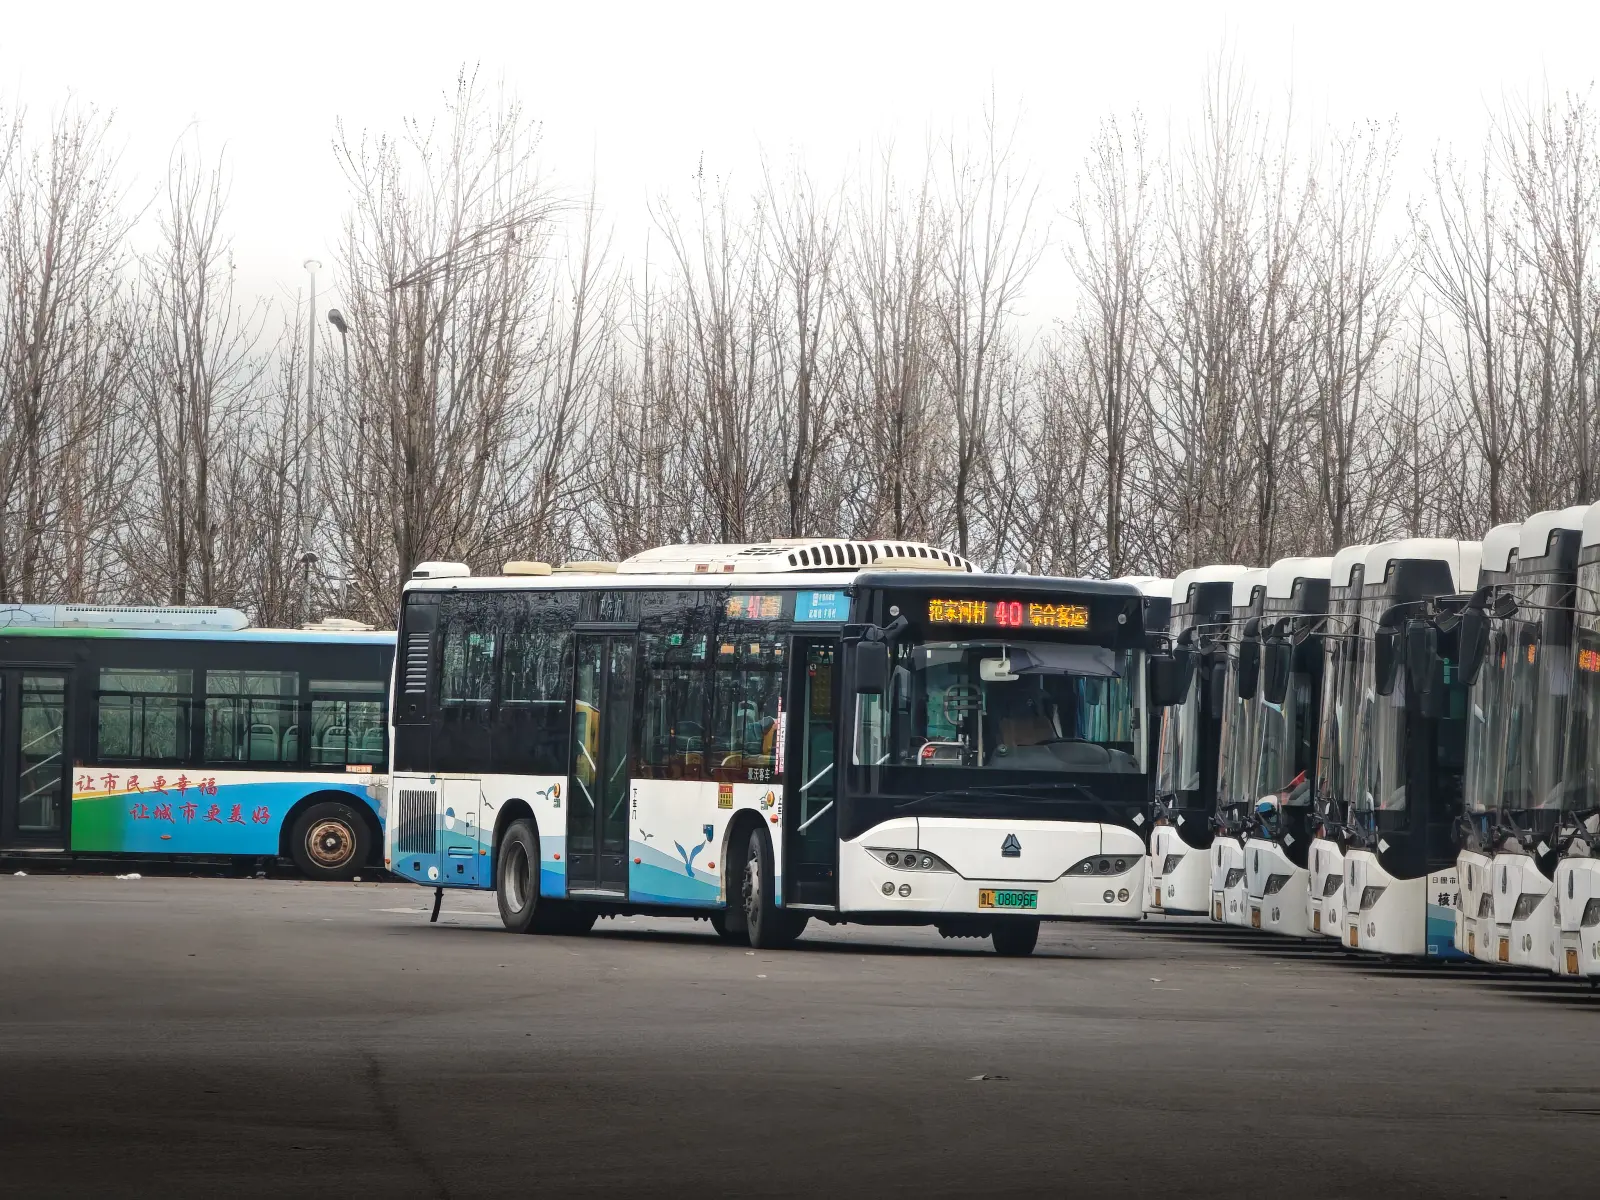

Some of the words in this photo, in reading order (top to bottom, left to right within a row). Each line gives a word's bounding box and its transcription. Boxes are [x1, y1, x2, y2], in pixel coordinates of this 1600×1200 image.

[929, 600, 986, 623] 范家河村
[995, 602, 1022, 625] 40
[1029, 603, 1088, 627] 综合客运
[75, 773, 218, 796] 让市民更幸福
[130, 802, 270, 825] 让城市更美好
